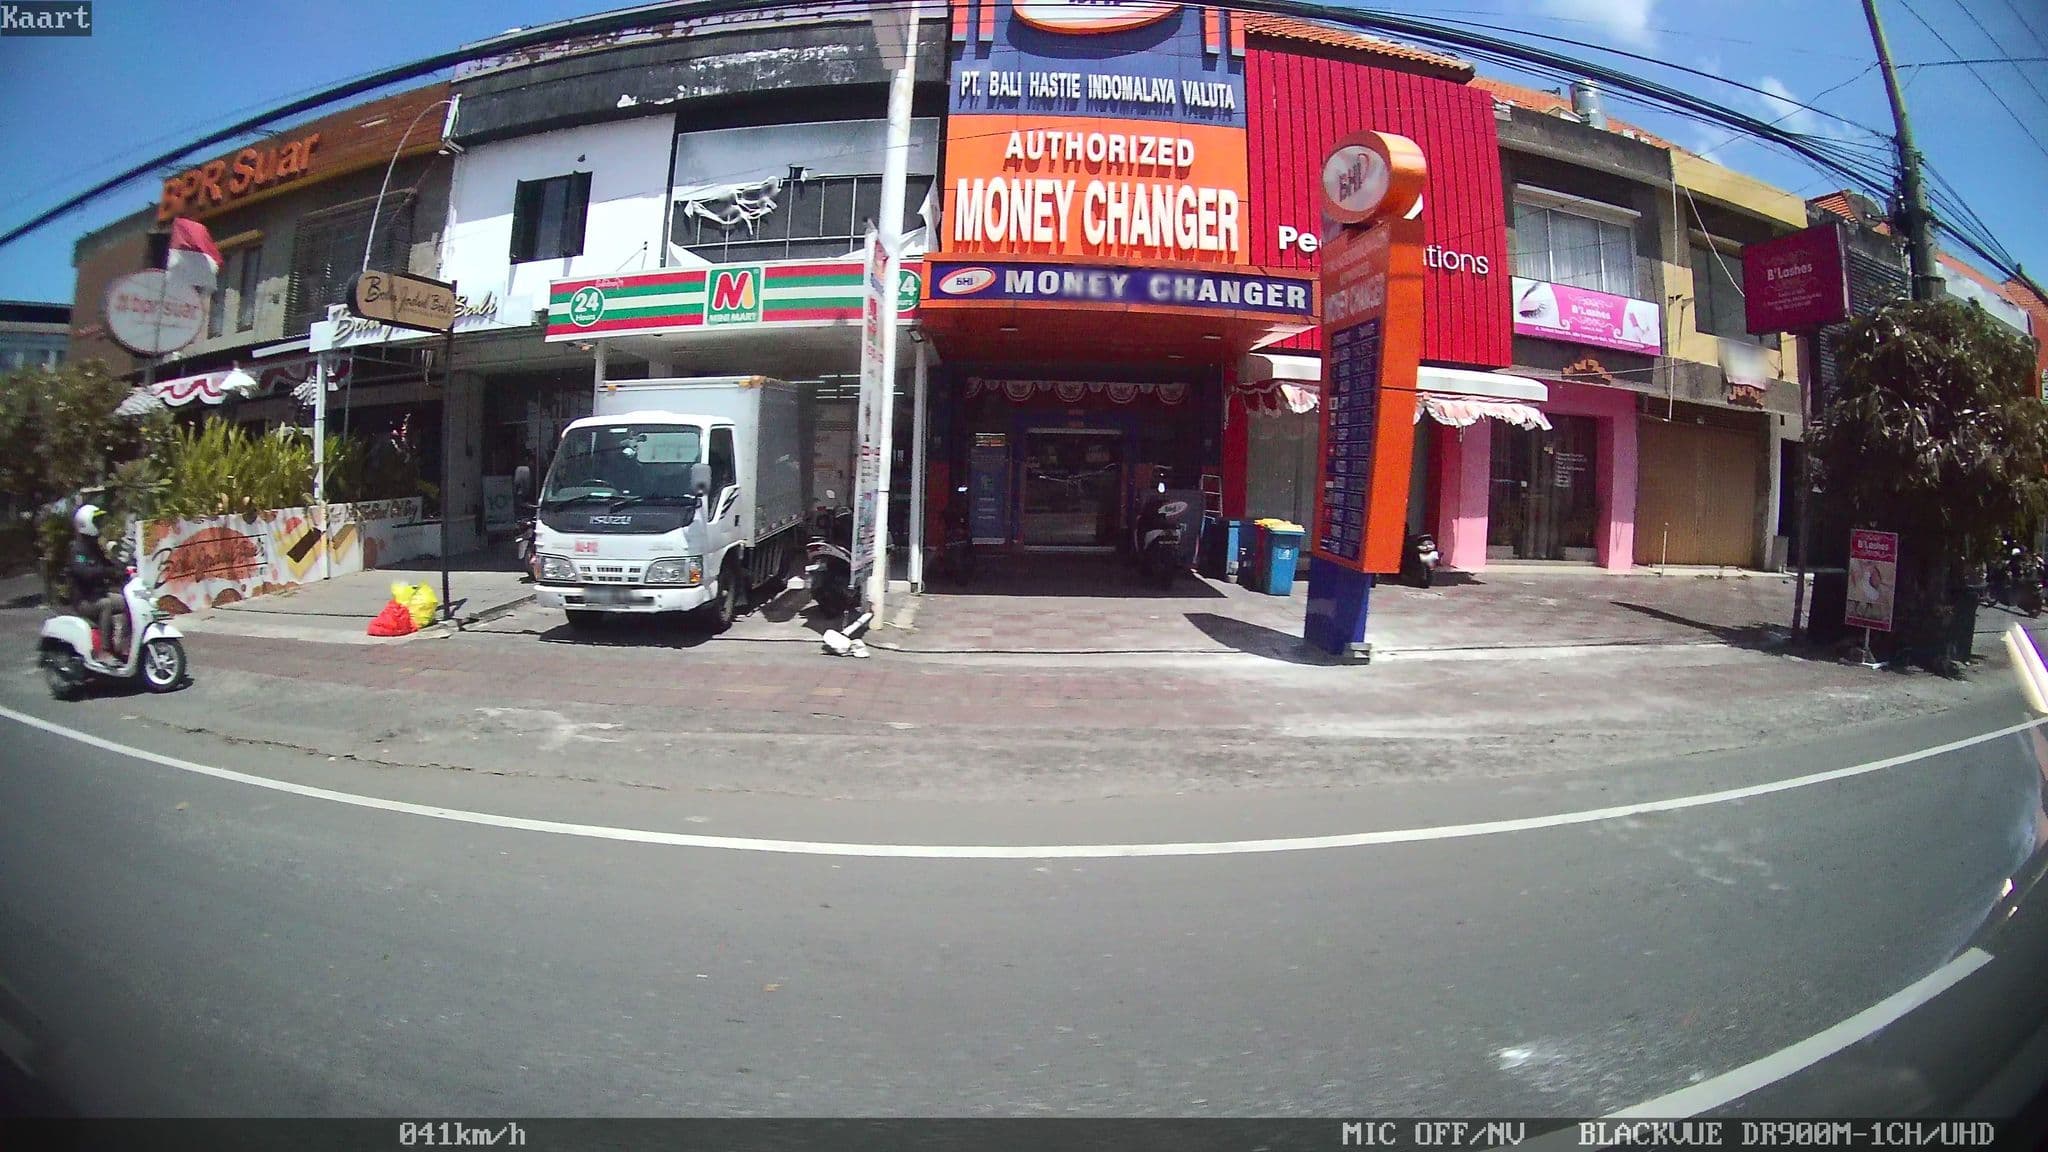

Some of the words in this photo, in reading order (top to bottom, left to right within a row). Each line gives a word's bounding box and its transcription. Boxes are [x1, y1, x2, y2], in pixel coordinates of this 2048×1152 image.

[961, 71, 981, 97] PT.
[989, 71, 1021, 97] BALI
[1029, 71, 1081, 99] HASTIE
[1088, 74, 1176, 104] INDOMALAYA
[1182, 79, 1235, 109] VALUTA
[1005, 130, 1195, 167] AUTHORIZED
[157, 160, 225, 221] BPR
[229, 133, 320, 193] Suar
[954, 177, 1076, 243] MONEY
[1083, 181, 1240, 252] CHANGER
[1278, 226, 1321, 253] Pe
[1423, 245, 1490, 275] tions
[1767, 263, 1813, 280] B'Lashes
[574, 291, 600, 313] 24
[1004, 269, 1130, 297] MONEY
[1150, 273, 1307, 309] CHANGER
[453, 291, 499, 318] Bali
[731, 312, 757, 321] MART
[590, 515, 632, 525] ISUZU
